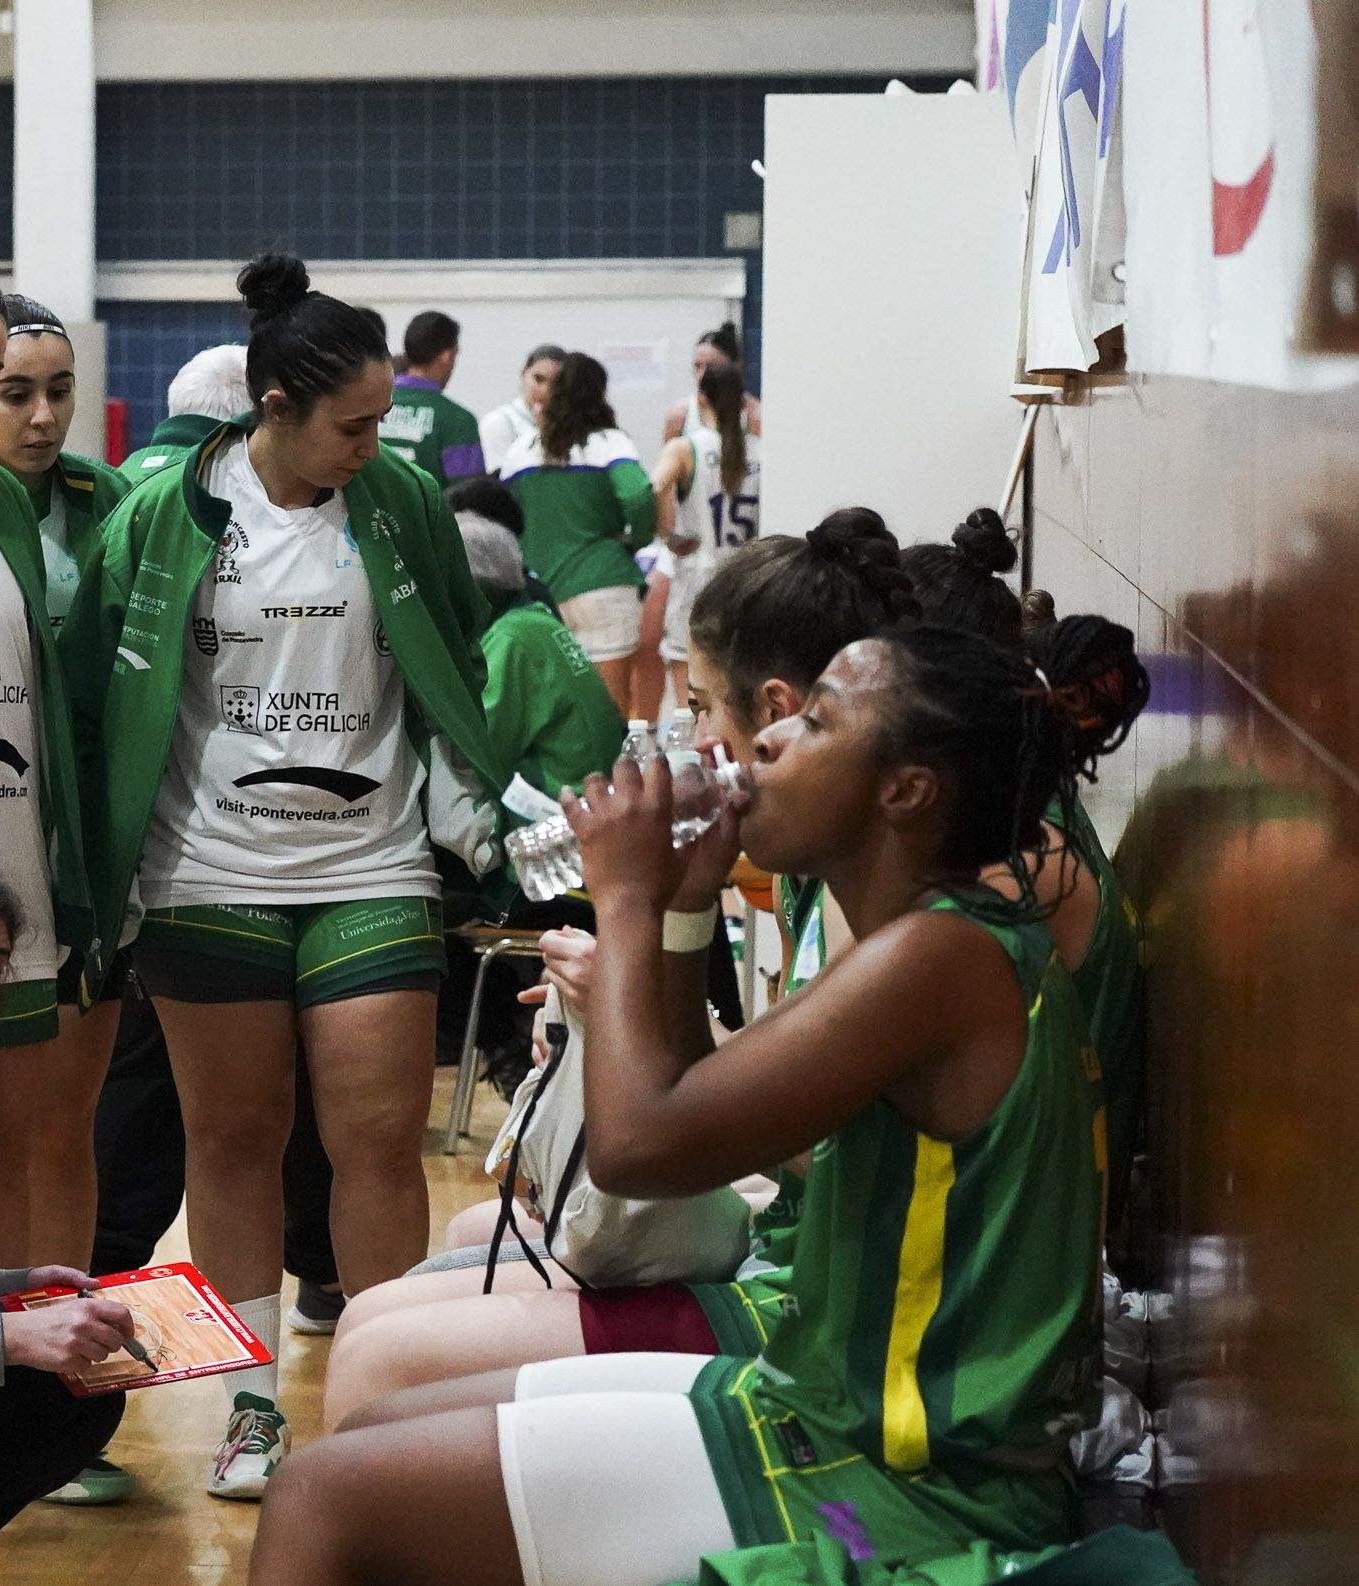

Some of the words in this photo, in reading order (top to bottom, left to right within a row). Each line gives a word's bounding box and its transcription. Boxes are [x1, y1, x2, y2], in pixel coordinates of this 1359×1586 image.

[708, 493, 760, 547] 15
[266, 692, 339, 710] XUNTA
[265, 715, 291, 732] DE
[297, 713, 370, 732] GALICIA
[216, 797, 370, 821] visit-pontevedra.com
